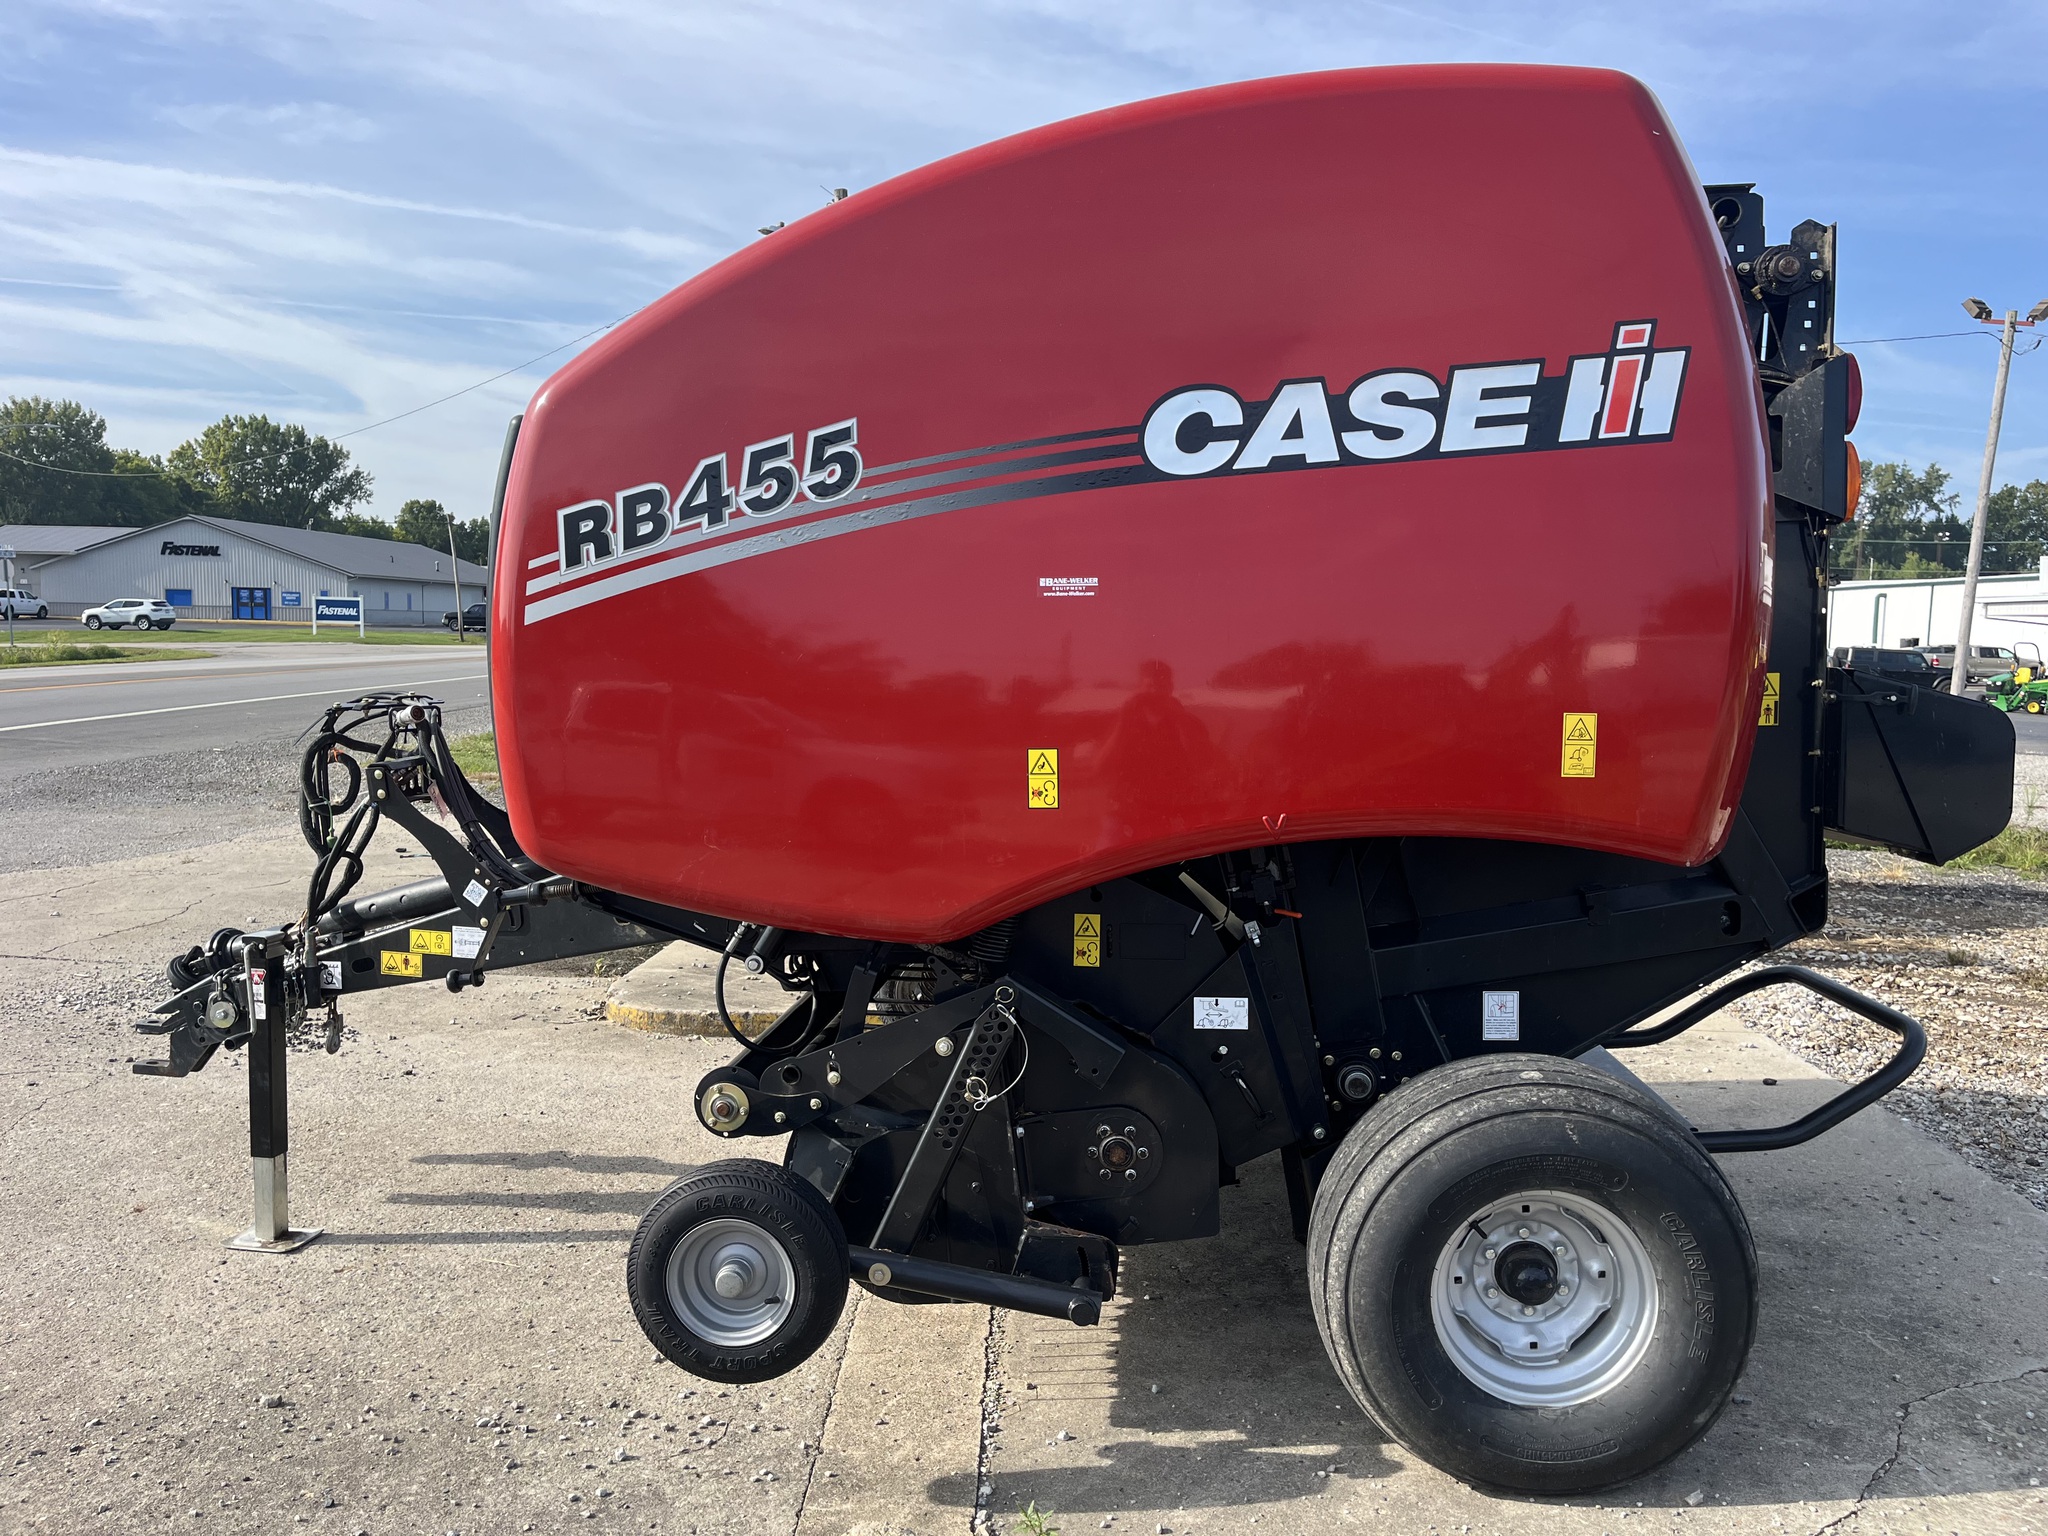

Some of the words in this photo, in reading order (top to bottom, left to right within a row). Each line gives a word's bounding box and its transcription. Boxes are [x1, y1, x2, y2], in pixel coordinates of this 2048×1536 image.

[1141, 362, 1541, 477] CASE
[556, 417, 864, 577] RB455
[160, 541, 222, 557] FASTENAL
[317, 604, 358, 616] FASTENAL
[695, 1193, 806, 1250] CARLISLE
[1659, 1211, 1715, 1365] CARLISLE
[647, 1302, 701, 1362] TRAIL
[708, 1342, 788, 1371] SPORT
